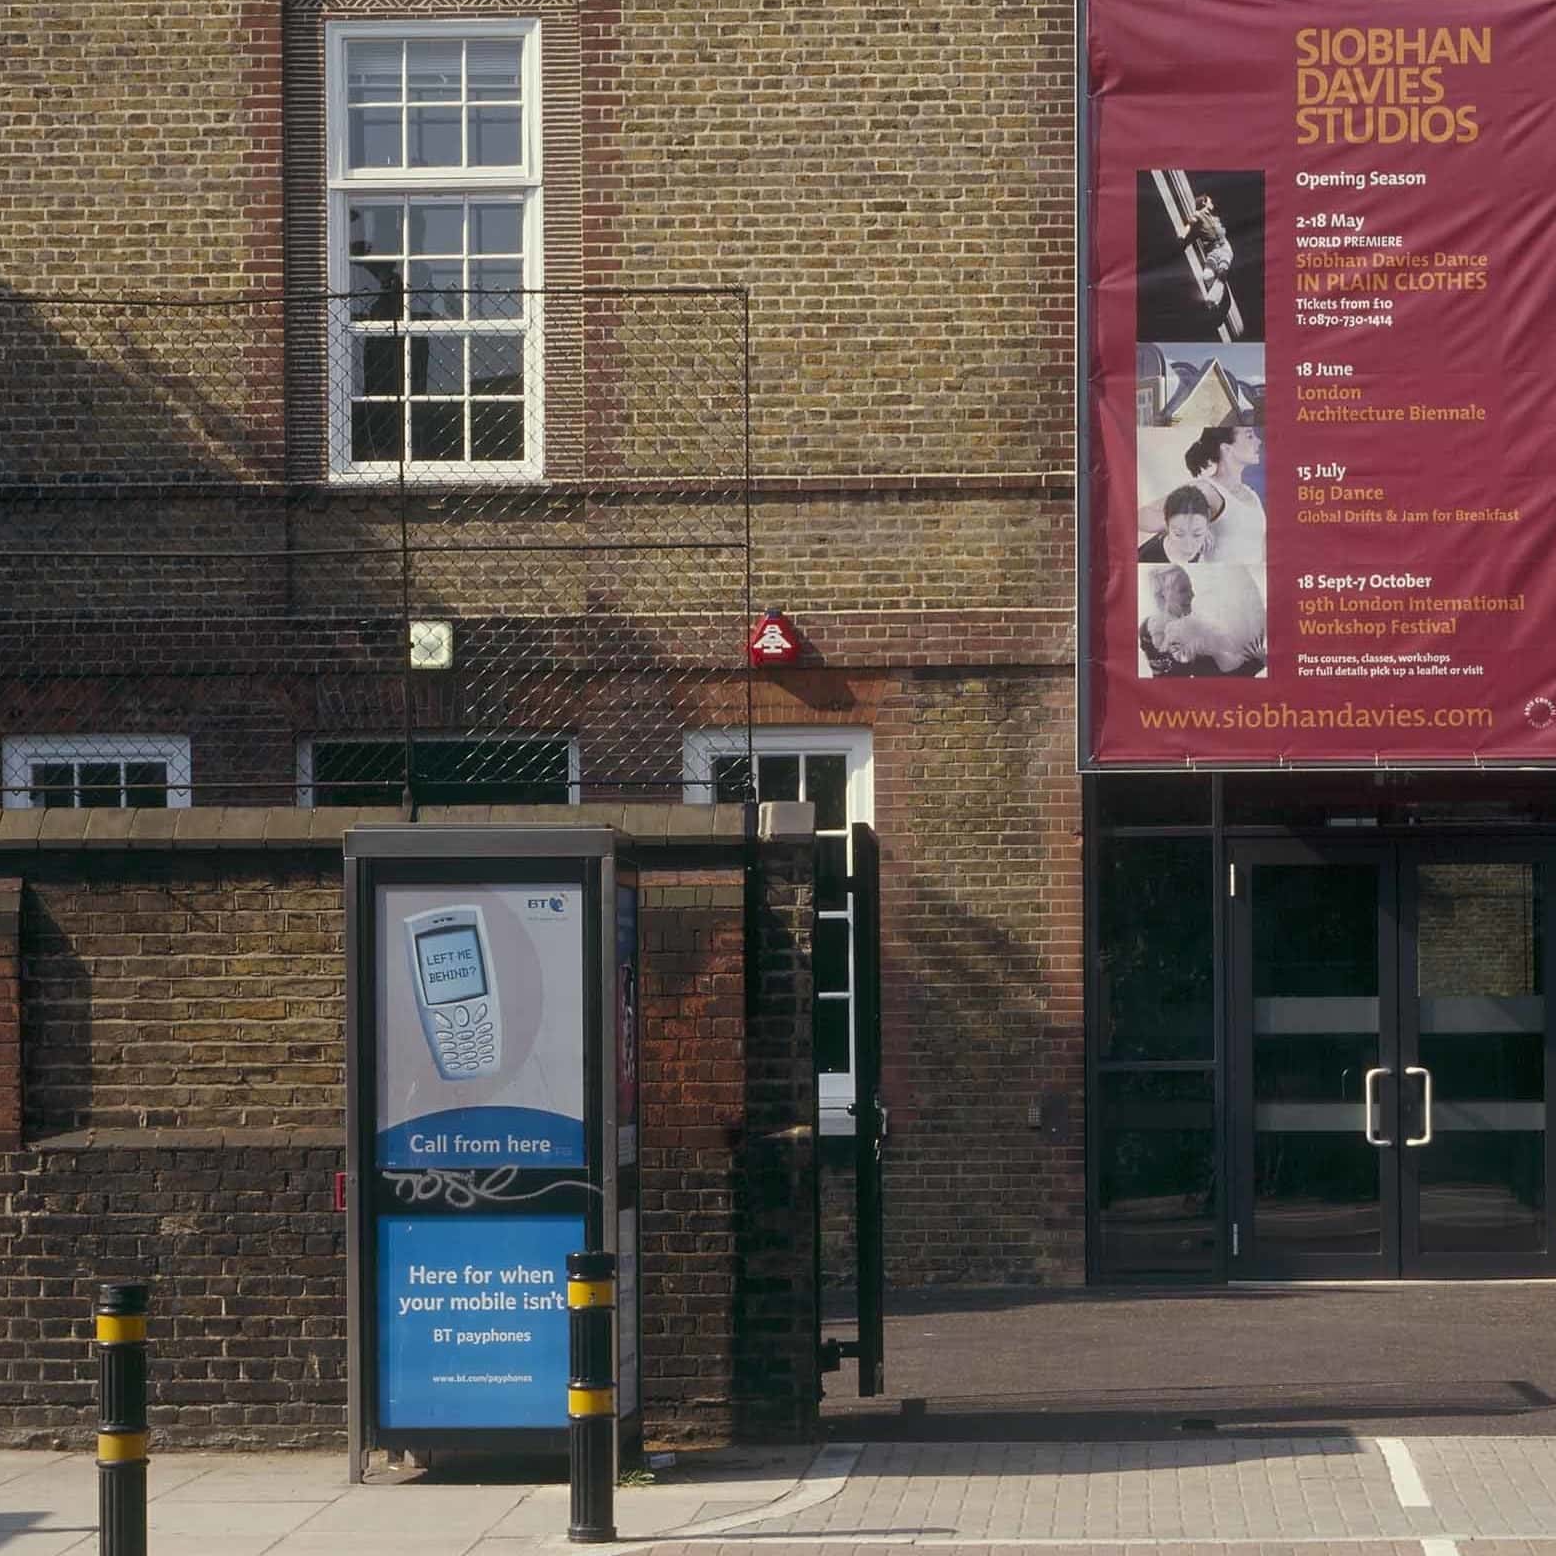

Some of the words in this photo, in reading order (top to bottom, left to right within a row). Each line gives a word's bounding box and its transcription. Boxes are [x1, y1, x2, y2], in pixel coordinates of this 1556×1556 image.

[1296, 28, 1492, 65] SIOBHAN
[1297, 67, 1444, 105] DAVIES
[1296, 106, 1479, 144] STUDIOS
[1296, 171, 1365, 189] Opening
[1369, 171, 1426, 186] Season
[1296, 214, 1326, 228] 2-18
[1331, 214, 1364, 231] May
[1296, 236, 1341, 247] WORLD
[1344, 236, 1403, 247] PREMIERE
[1296, 252, 1367, 268] Siobhan
[1372, 252, 1429, 267] Davies
[1434, 251, 1488, 267] Dance
[1297, 273, 1319, 292] IN
[1326, 272, 1388, 291] PLAIN
[1395, 271, 1487, 291] CLOTHES
[1296, 298, 1337, 310] Tickets
[1340, 298, 1370, 310] from
[1373, 299, 1393, 310] £10
[1297, 314, 1306, 326] T:
[1309, 314, 1392, 327] 0870-730-1414
[1296, 362, 1312, 377] 18
[1316, 363, 1353, 377] June
[1297, 385, 1362, 400] London
[1297, 405, 1405, 422] Architecture
[1410, 404, 1486, 421] Biennale
[1297, 466, 1312, 480] 15
[1315, 462, 1346, 481] July
[1298, 486, 1325, 505] Big
[1331, 486, 1384, 501] Dance
[1298, 510, 1341, 523] Global
[1345, 510, 1382, 522] Drifts
[1386, 510, 1398, 522] &
[1402, 510, 1428, 522] Jam
[1432, 509, 1453, 522] for
[1456, 508, 1520, 522] Breakfast
[1298, 575, 1313, 589] 18
[1318, 574, 1366, 591] Sept-7
[1370, 573, 1432, 589] October
[1298, 596, 1334, 614] 19th
[1340, 596, 1404, 612] London
[1409, 594, 1525, 611] International
[1299, 618, 1386, 637] Workshop
[1391, 618, 1457, 635] Festival
[1298, 653, 1318, 663] Plus
[1321, 654, 1359, 665] courses,
[1361, 653, 1396, 664] classes,
[1398, 653, 1451, 665] workshops
[1298, 666, 1313, 676] For
[1315, 666, 1333, 676] full
[1335, 666, 1368, 676] details
[1370, 665, 1390, 677] pick
[1393, 667, 1406, 677] up
[1416, 665, 1448, 675] leaflet
[1450, 667, 1460, 675] or
[1462, 665, 1484, 675] visit
[1140, 702, 1493, 730] www.siobhandavies.com
[528, 899, 548, 909] BT
[427, 952, 453, 965] LEFT
[458, 949, 474, 961] ME
[429, 966, 476, 984] BEHIND?
[410, 1134, 447, 1153] Call
[453, 1134, 500, 1153] from
[508, 1134, 551, 1153] here
[409, 1265, 457, 1284] Here
[463, 1265, 492, 1284] for
[500, 1265, 554, 1284] when
[398, 1296, 444, 1315] your
[450, 1292, 517, 1310] mobile
[523, 1291, 564, 1310] isn't
[433, 1329, 452, 1342] BT
[457, 1329, 532, 1344] payphones
